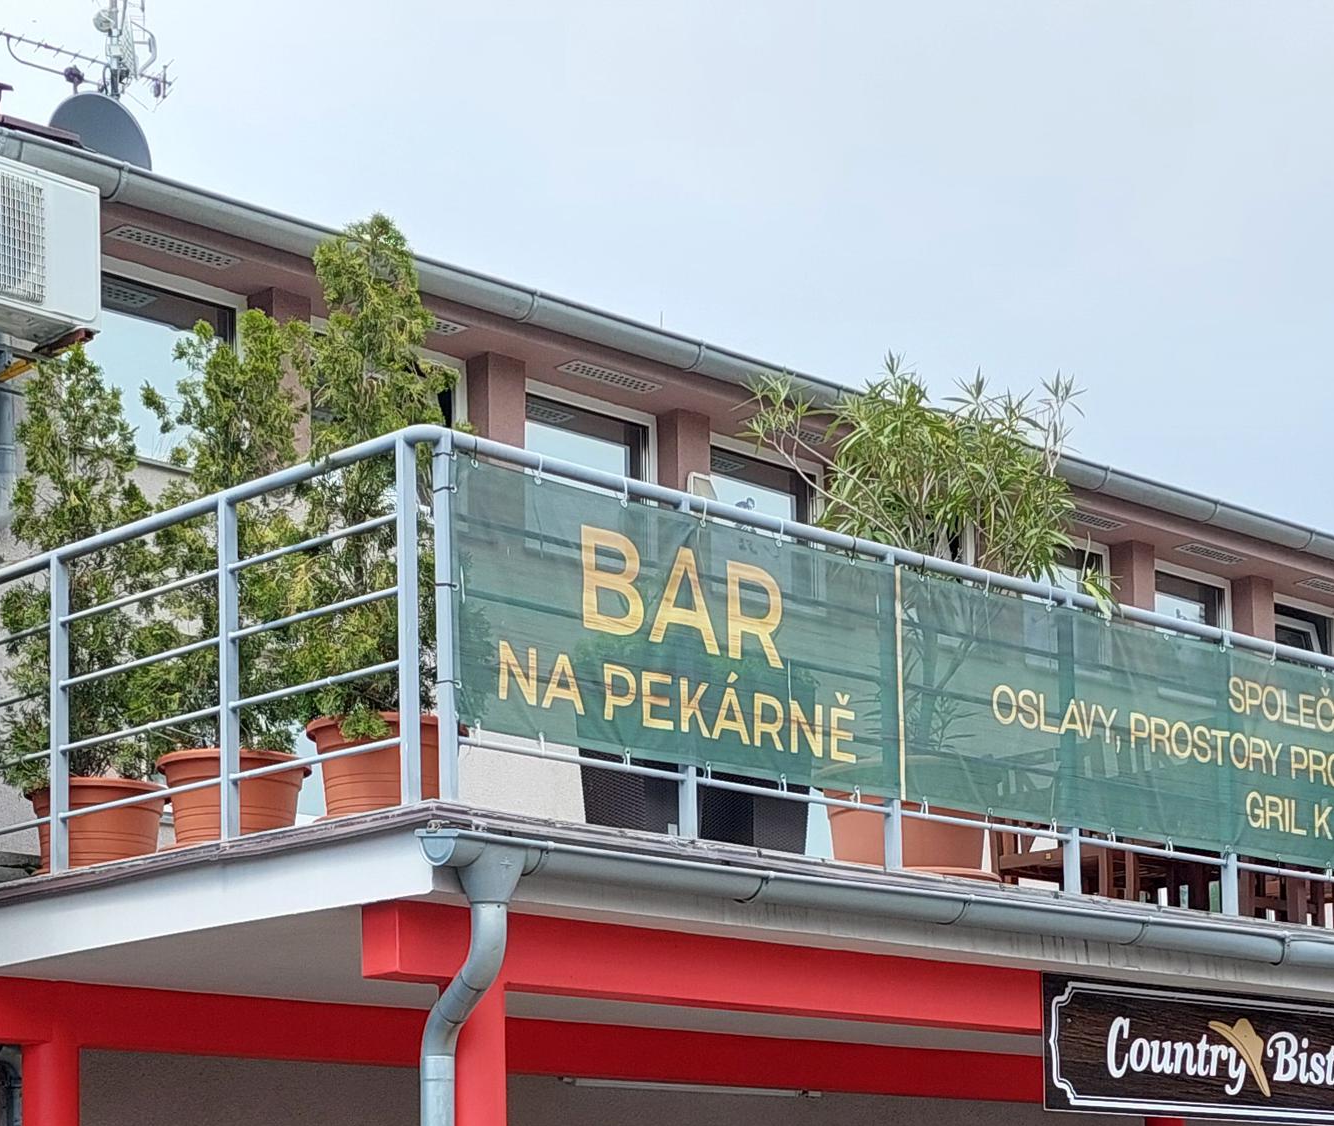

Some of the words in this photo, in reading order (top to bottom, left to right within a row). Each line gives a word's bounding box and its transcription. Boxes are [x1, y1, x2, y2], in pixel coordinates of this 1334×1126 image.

[580, 523, 784, 669] BAR
[498, 640, 586, 716] NA
[603, 662, 857, 765] PEKÁRNĚ
[992, 683, 1123, 754] OSLAVY,
[1130, 712, 1282, 777] PROSTORY
[1246, 791, 1307, 836] GRIL
[1314, 806, 1333, 840] K
[1107, 1016, 1246, 1096] Country
